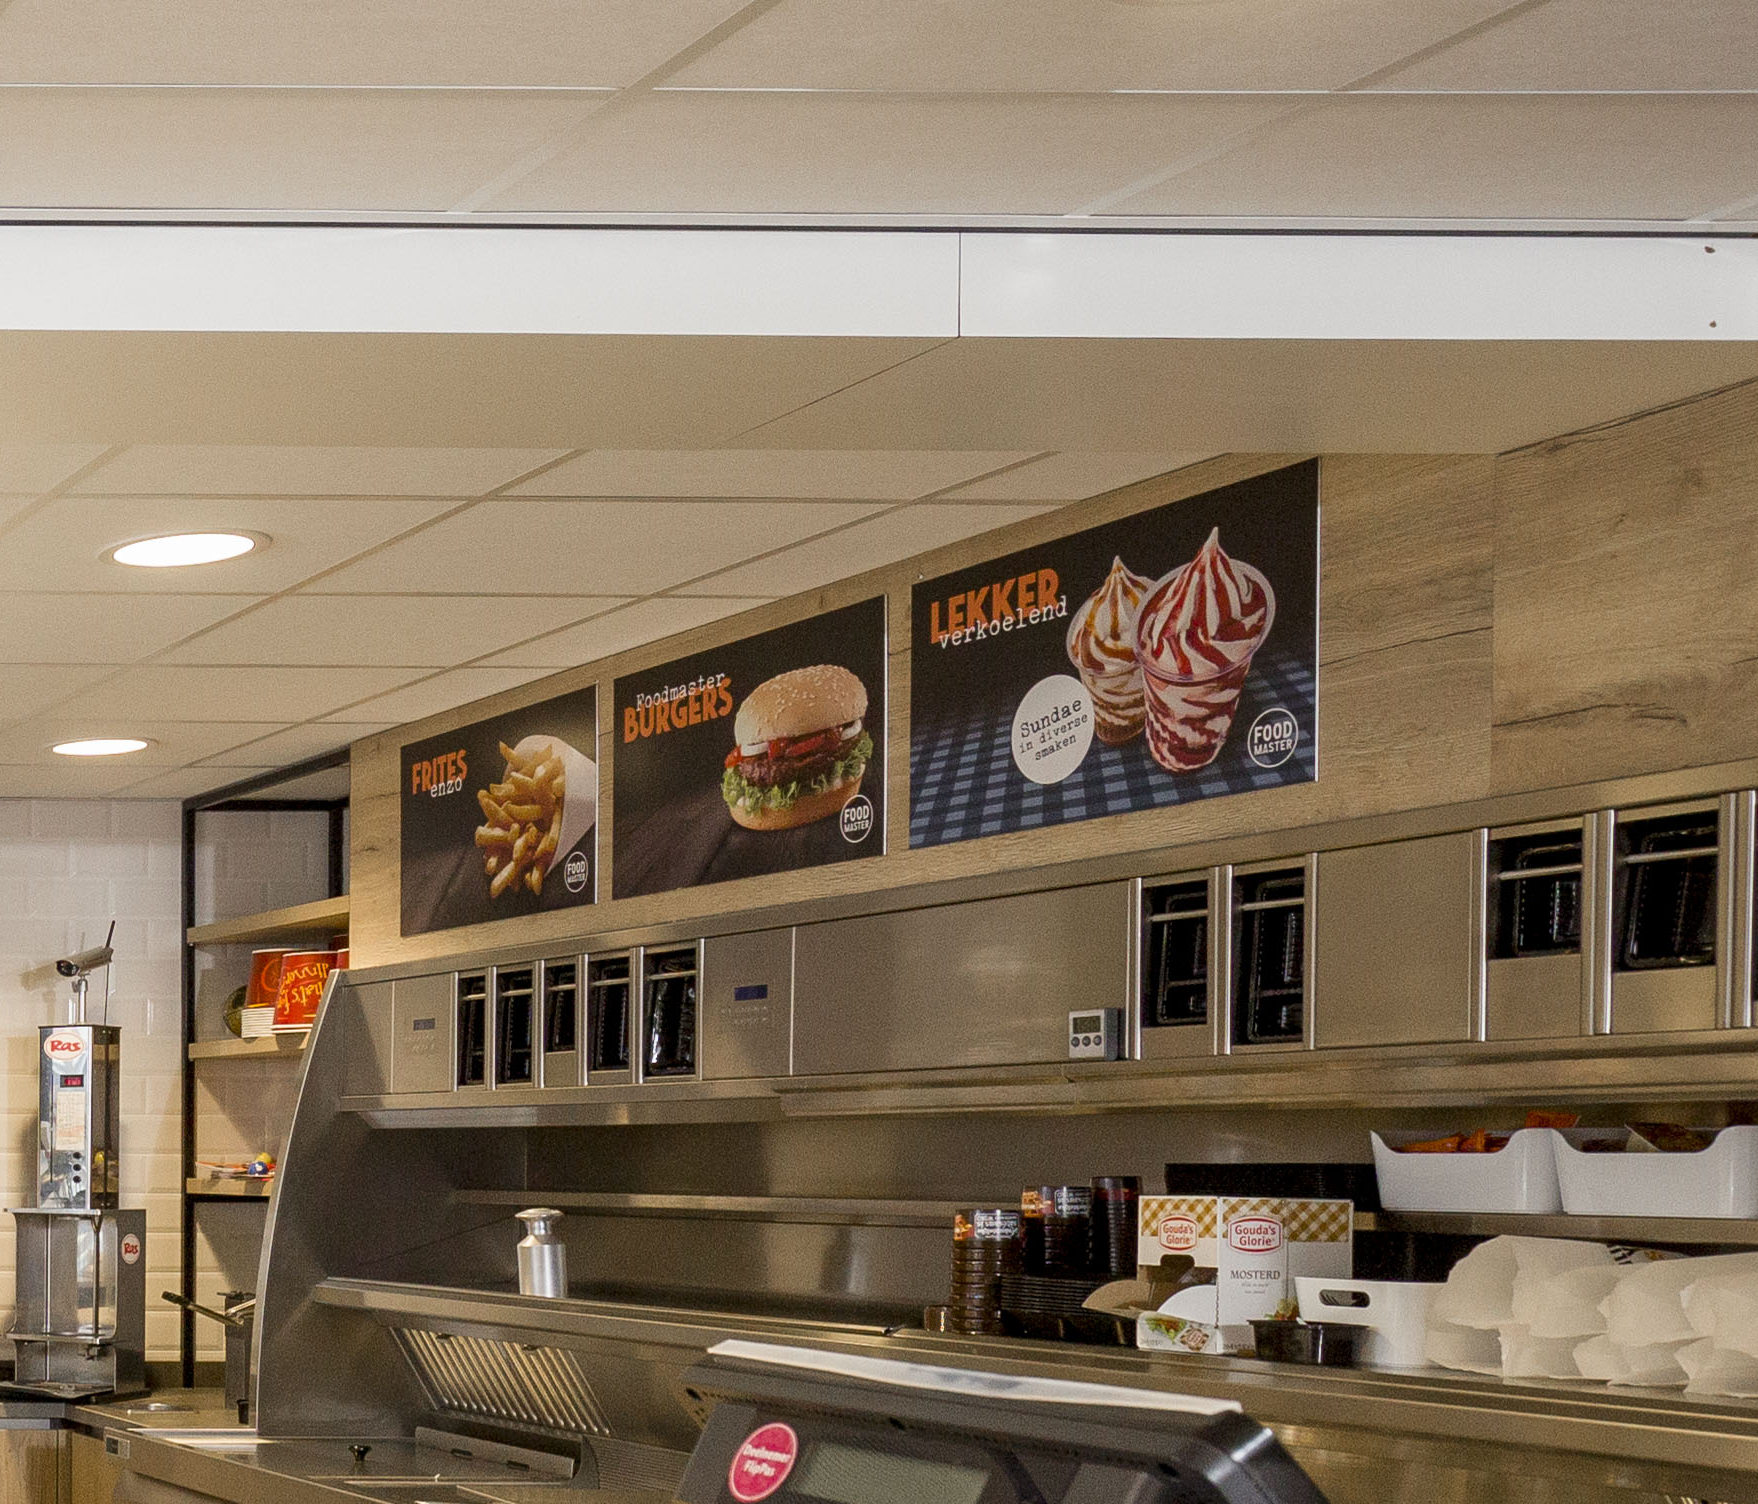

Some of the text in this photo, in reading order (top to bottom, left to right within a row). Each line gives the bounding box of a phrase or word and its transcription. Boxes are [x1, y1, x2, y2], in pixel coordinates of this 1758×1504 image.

[930, 568, 1060, 645] LEKKER
[939, 595, 1068, 649] verkoelend
[636, 672, 726, 711] Foodmaster
[624, 677, 733, 743] BURGERS
[1020, 699, 1082, 738] Sundae
[1019, 713, 1088, 754] in diverse
[1253, 721, 1293, 744] FOOD
[1034, 734, 1077, 761] smaken
[1253, 739, 1293, 755] MASTER
[412, 749, 468, 795] FRITES
[430, 777, 463, 798] enzo
[844, 805, 870, 823] FOOD
[844, 820, 870, 832] MASTER
[567, 861, 586, 876] FOOD
[50, 1039, 82, 1053] Ras
[1163, 1223, 1194, 1235] Gouda's
[1235, 1224, 1277, 1237] Gouda's
[123, 1242, 139, 1255] Ras
[1166, 1233, 1191, 1245] Glorie
[1239, 1236, 1273, 1247] Glorie
[1230, 1269, 1281, 1280] MOSTERD
[742, 1443, 792, 1464] Deelnemer
